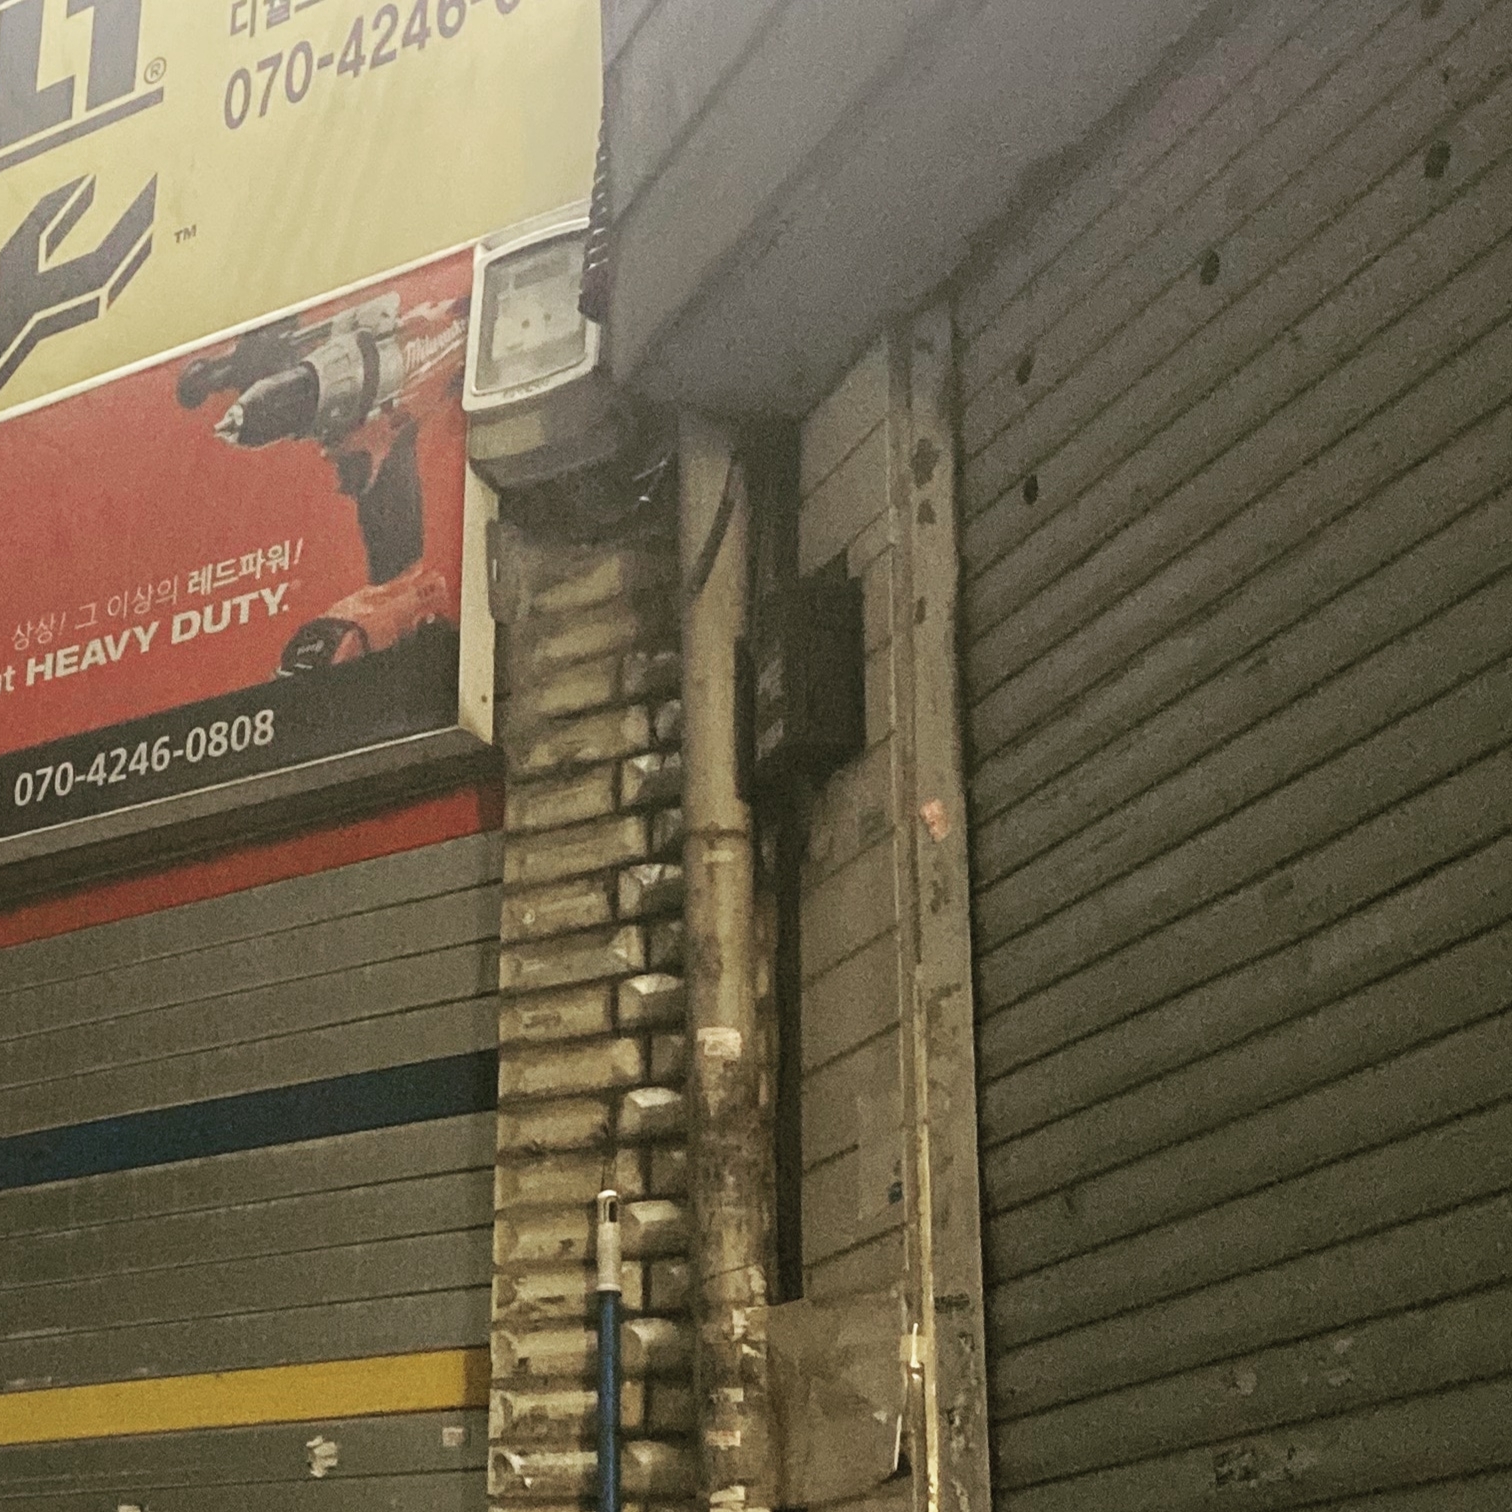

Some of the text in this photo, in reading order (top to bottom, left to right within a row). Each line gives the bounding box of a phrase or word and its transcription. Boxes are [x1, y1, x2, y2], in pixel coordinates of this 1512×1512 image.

[11, 611, 66, 651] 상상!
[74, 602, 99, 630] 그
[106, 574, 179, 619] 이상의
[186, 537, 304, 597] 레드파워!
[25, 621, 162, 687] HEAVY
[170, 582, 290, 645] DUTY.
[13, 708, 276, 808] 070-4246-0808
